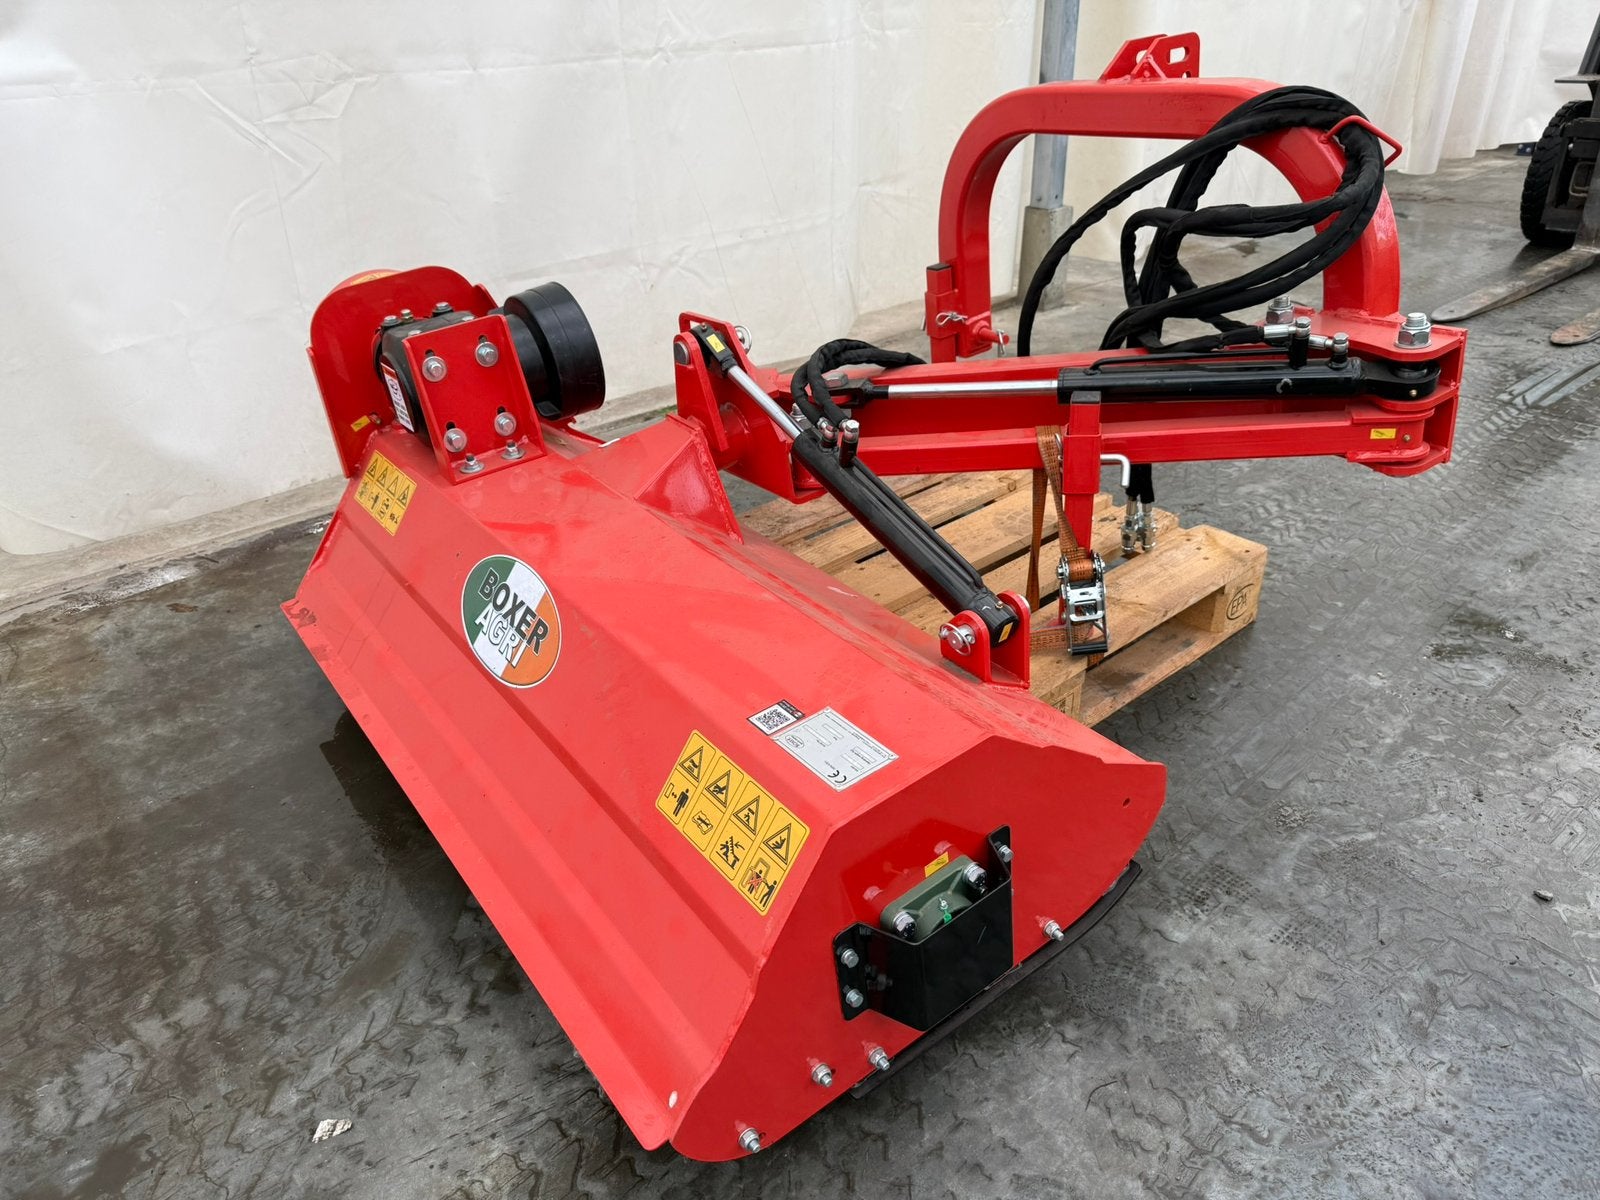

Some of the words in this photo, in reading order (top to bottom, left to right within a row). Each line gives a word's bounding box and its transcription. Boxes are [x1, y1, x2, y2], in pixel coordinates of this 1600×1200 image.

[474, 609, 528, 669] AGRI
[478, 567, 549, 655] BOXER
[827, 769, 847, 783] CE
